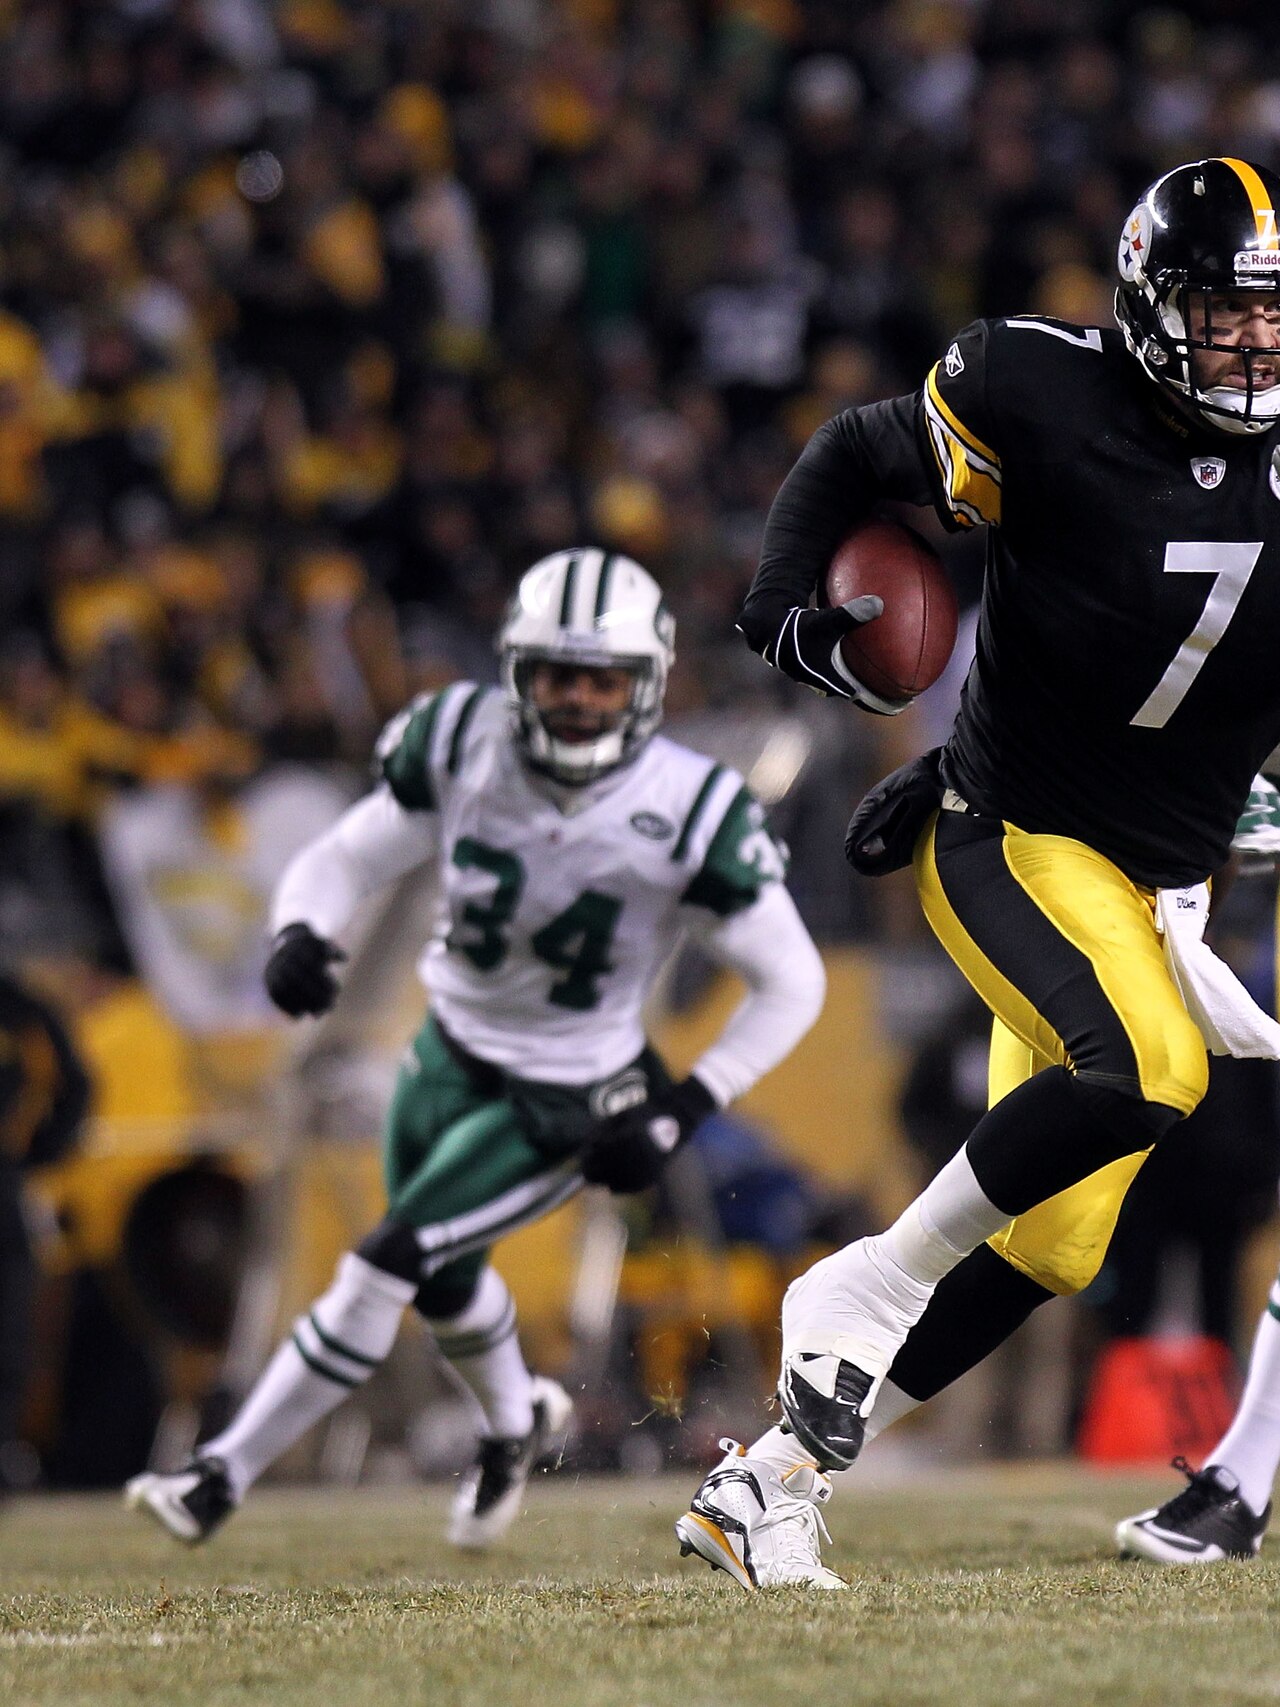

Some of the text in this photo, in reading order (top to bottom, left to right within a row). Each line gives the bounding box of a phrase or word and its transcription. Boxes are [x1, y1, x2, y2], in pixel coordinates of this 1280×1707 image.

[1256, 209, 1276, 250] 7
[1129, 541, 1264, 729] 7
[446, 835, 623, 1012] 34
